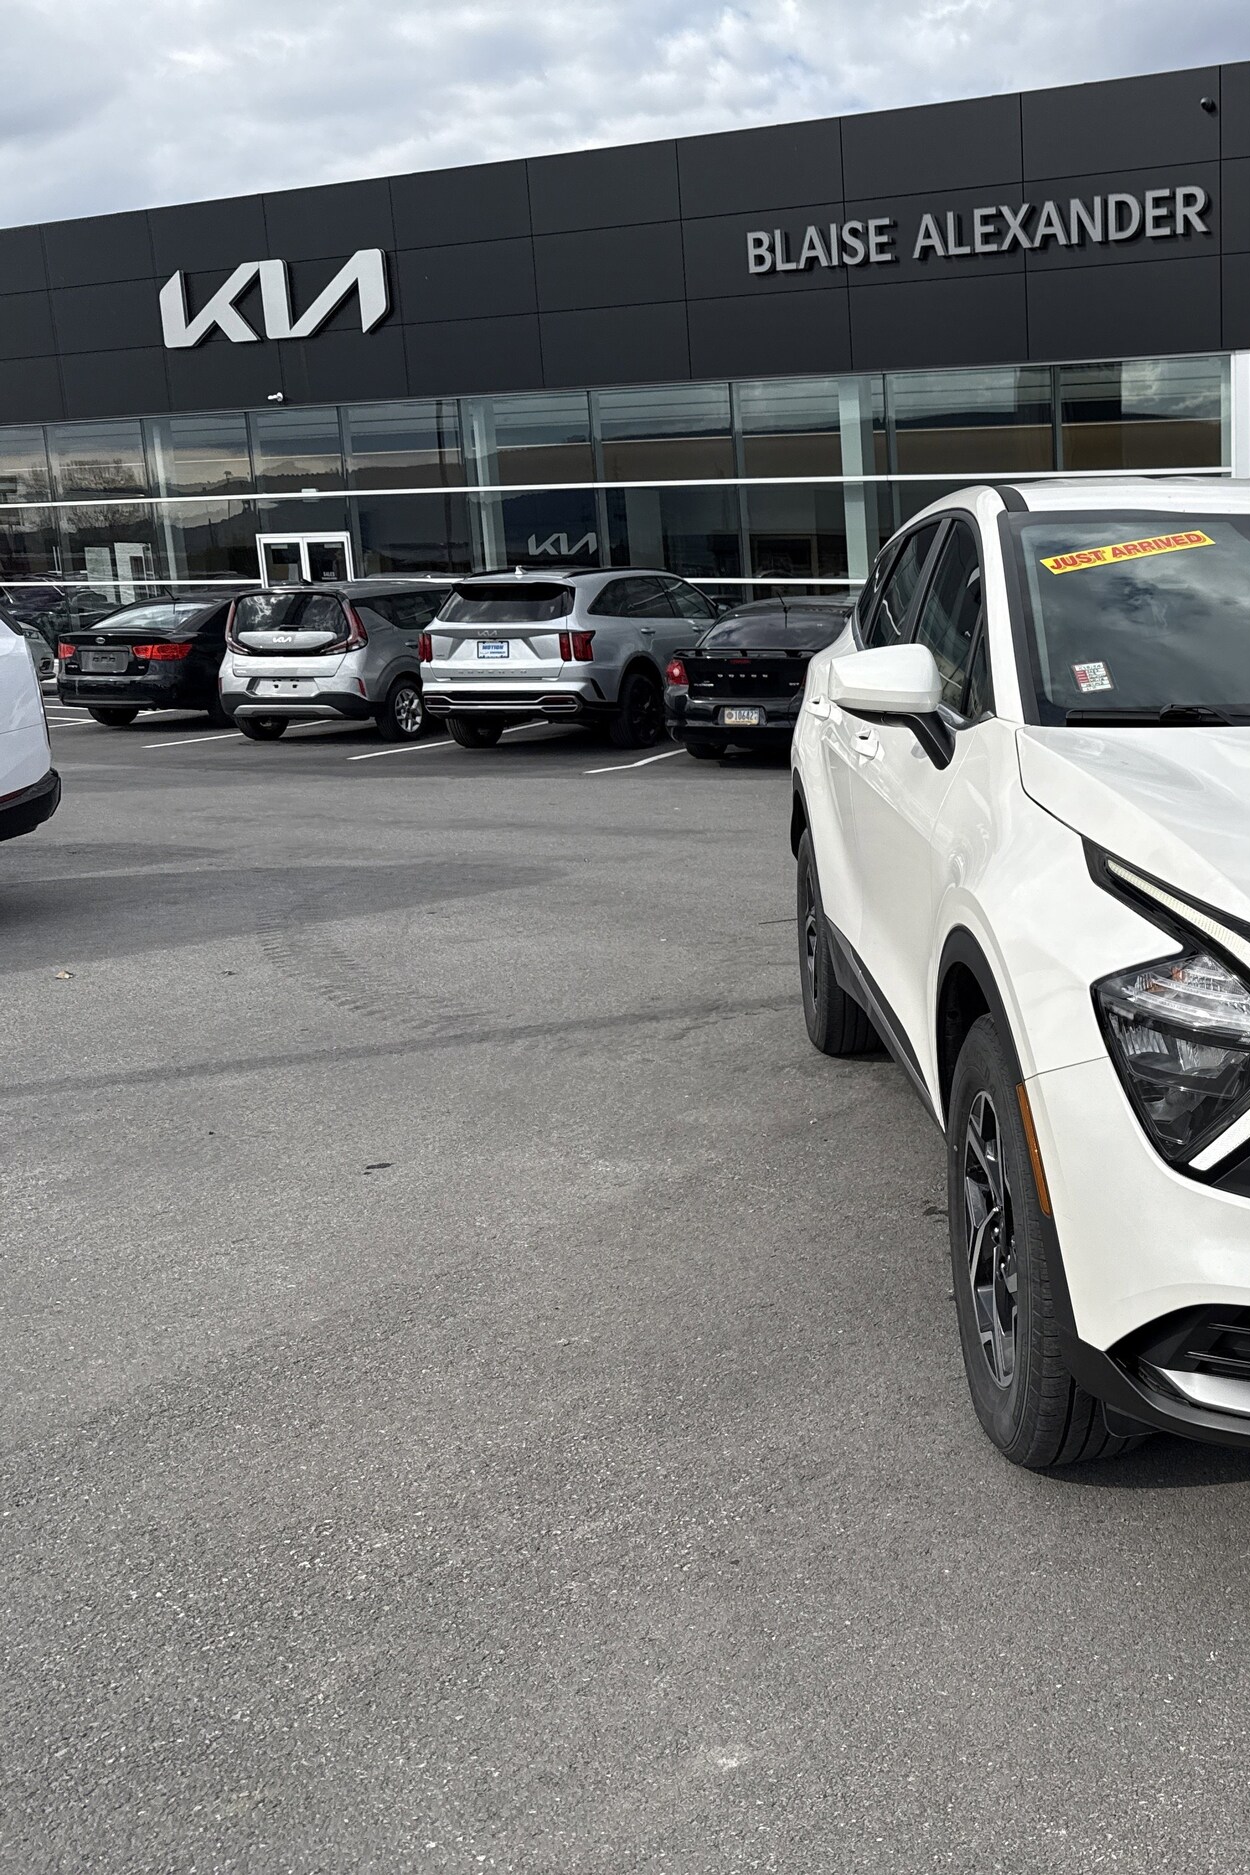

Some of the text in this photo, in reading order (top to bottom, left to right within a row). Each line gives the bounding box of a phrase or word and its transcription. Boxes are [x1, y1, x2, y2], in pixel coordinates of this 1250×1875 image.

[746, 185, 1208, 274] BLAISE ALEXANDER
[159, 248, 389, 348] KIA
[527, 532, 598, 556] KIA
[1050, 533, 1207, 571] JUST ARRIVED
